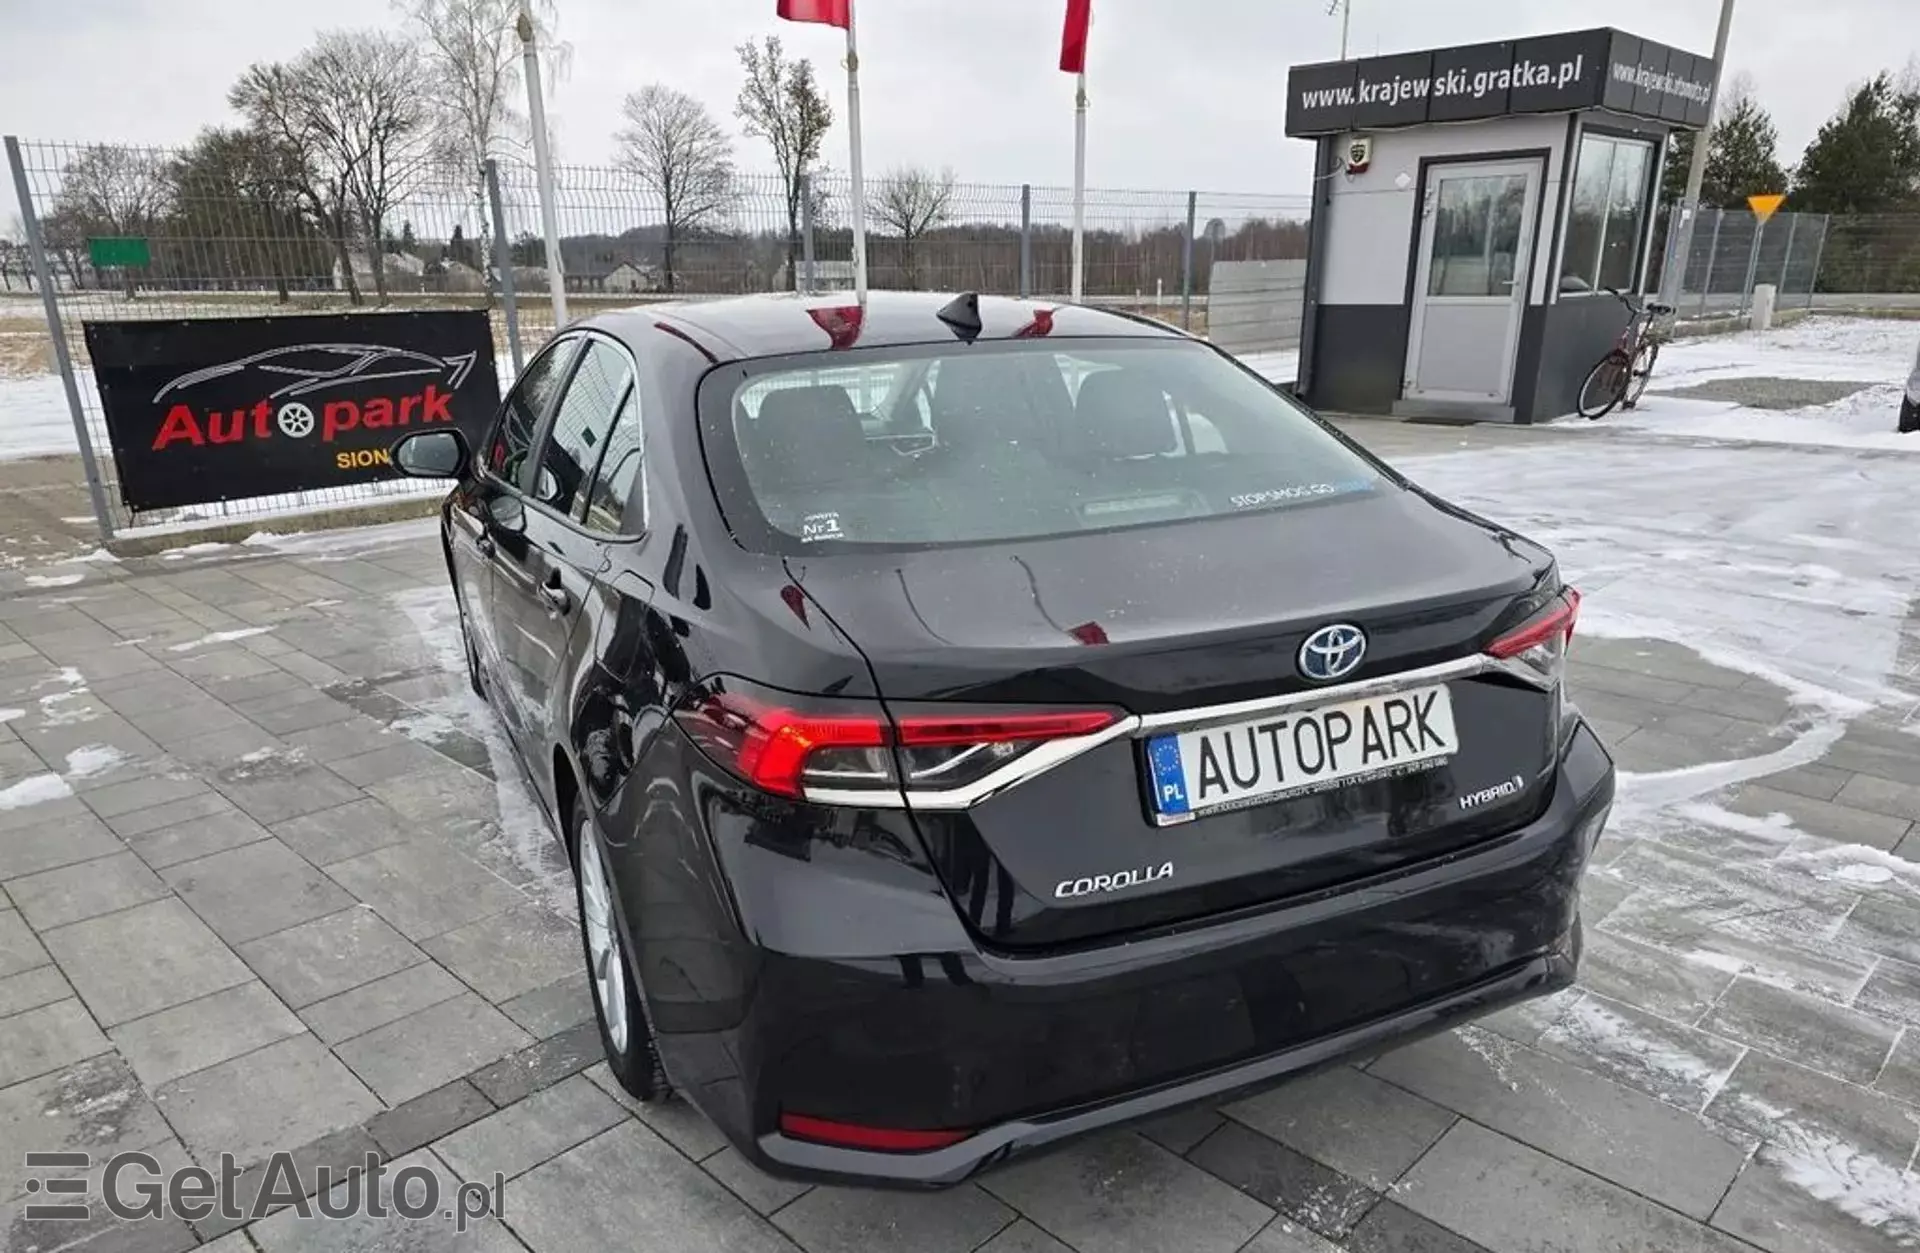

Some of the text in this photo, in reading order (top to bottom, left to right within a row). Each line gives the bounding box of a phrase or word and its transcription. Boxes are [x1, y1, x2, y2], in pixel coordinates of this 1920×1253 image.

[826, 519, 840, 531] 1
[1197, 690, 1446, 799] AUTOPARK
[1163, 784, 1184, 802] PL
[1459, 781, 1516, 809] HYBRID
[1055, 861, 1174, 898] COROLLA
